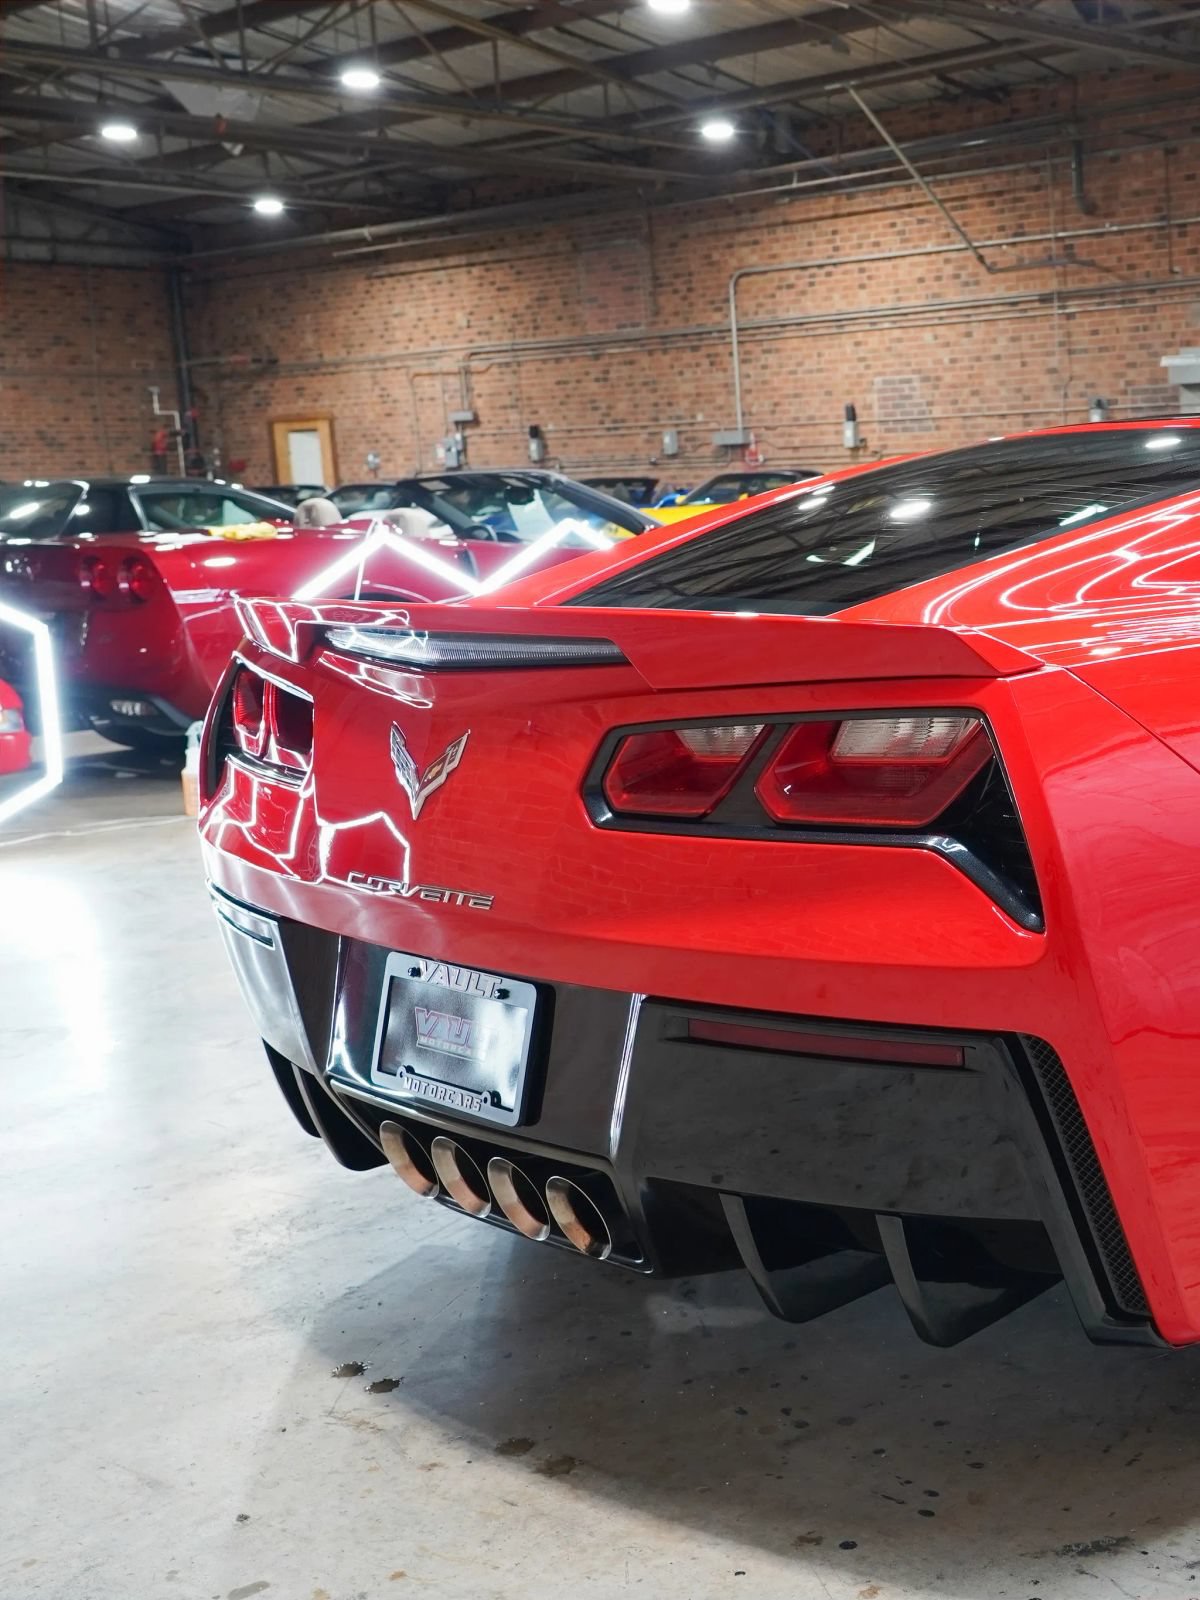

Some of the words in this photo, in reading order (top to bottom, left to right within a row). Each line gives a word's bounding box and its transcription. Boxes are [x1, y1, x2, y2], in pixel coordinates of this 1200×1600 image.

[347, 871, 495, 910] CORVETTE
[419, 959, 503, 999] VAULT
[402, 1075, 483, 1113] MOTORCARS
